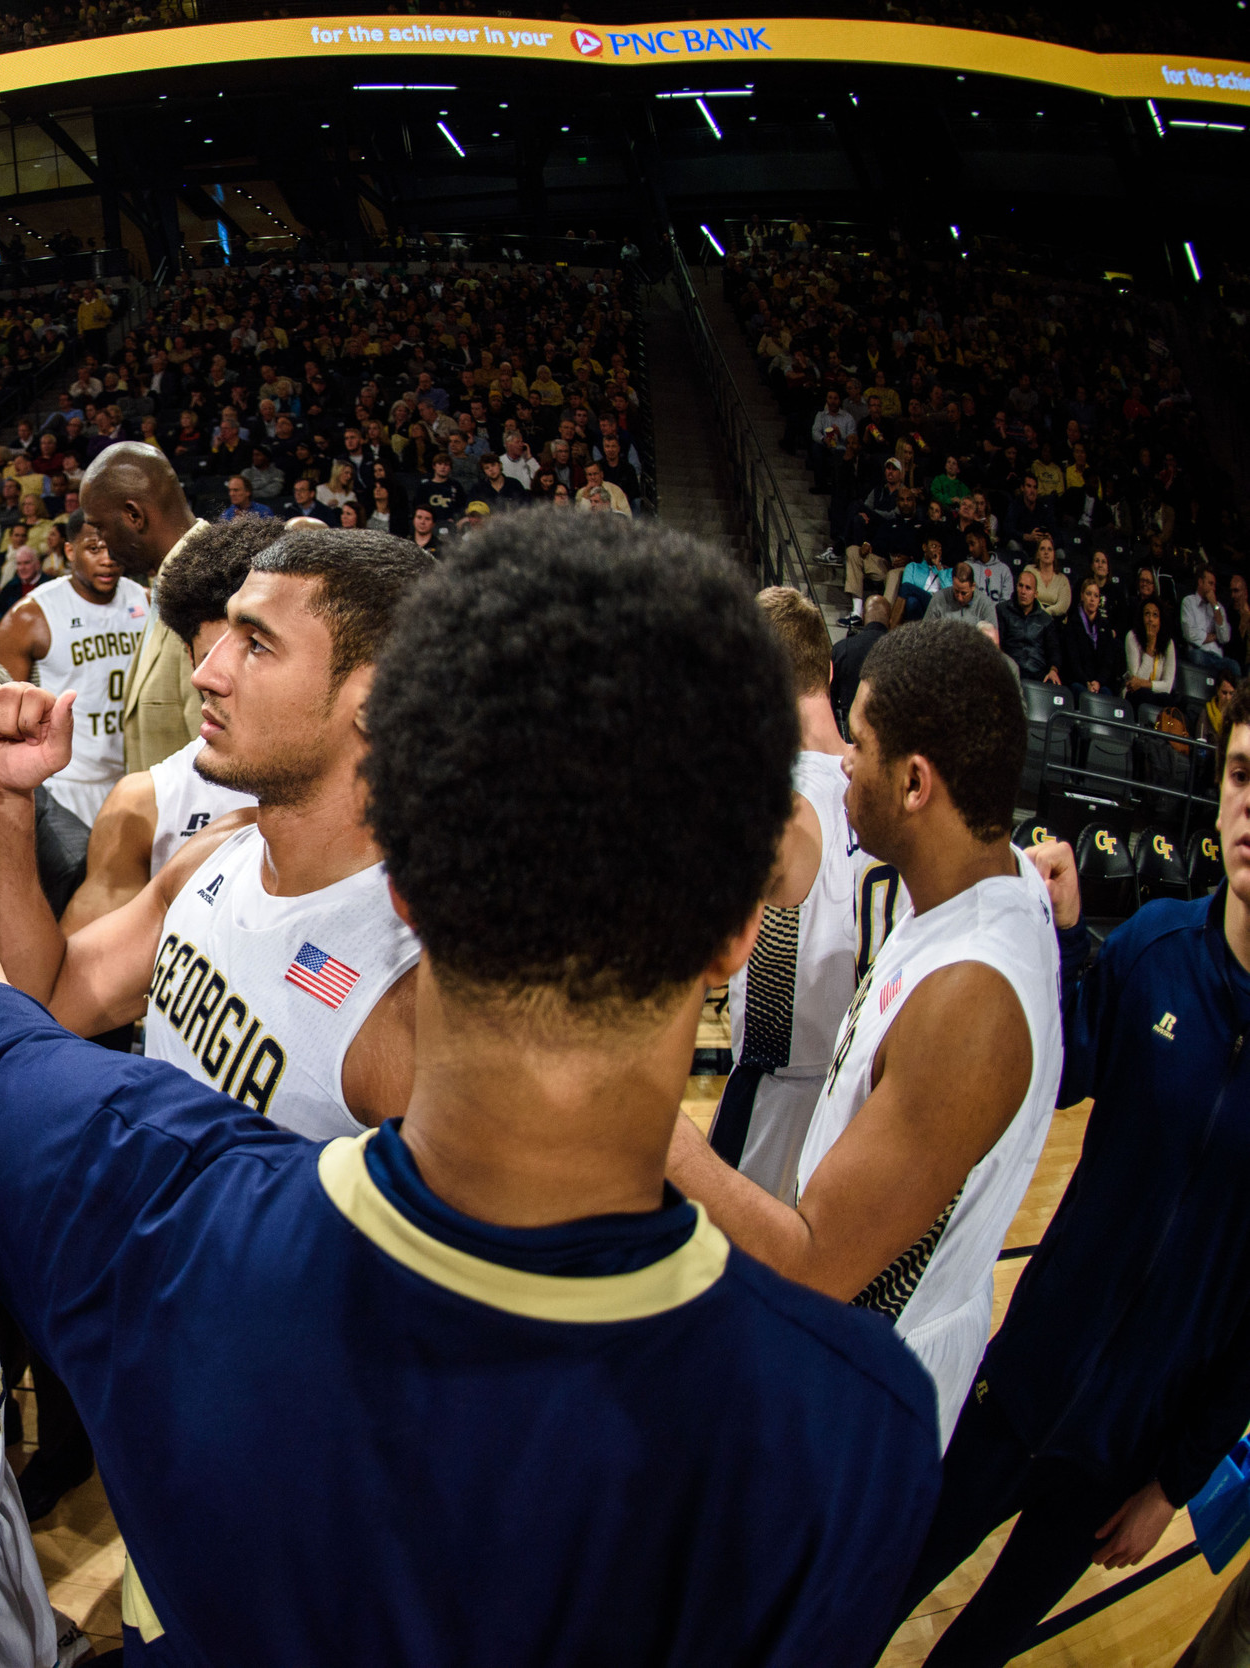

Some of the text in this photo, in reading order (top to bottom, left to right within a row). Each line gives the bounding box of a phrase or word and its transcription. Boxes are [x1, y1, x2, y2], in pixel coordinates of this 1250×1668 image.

[311, 26, 344, 43] for
[348, 25, 384, 42] the
[388, 24, 480, 43] achiever
[483, 26, 505, 44] in
[606, 27, 773, 56] PNC BANK
[1161, 65, 1185, 85] for
[1187, 67, 1215, 88] the
[108, 669, 125, 701] 0
[1095, 830, 1117, 855] GT
[1153, 835, 1174, 860] GT
[146, 931, 288, 1118] GEORGIA
